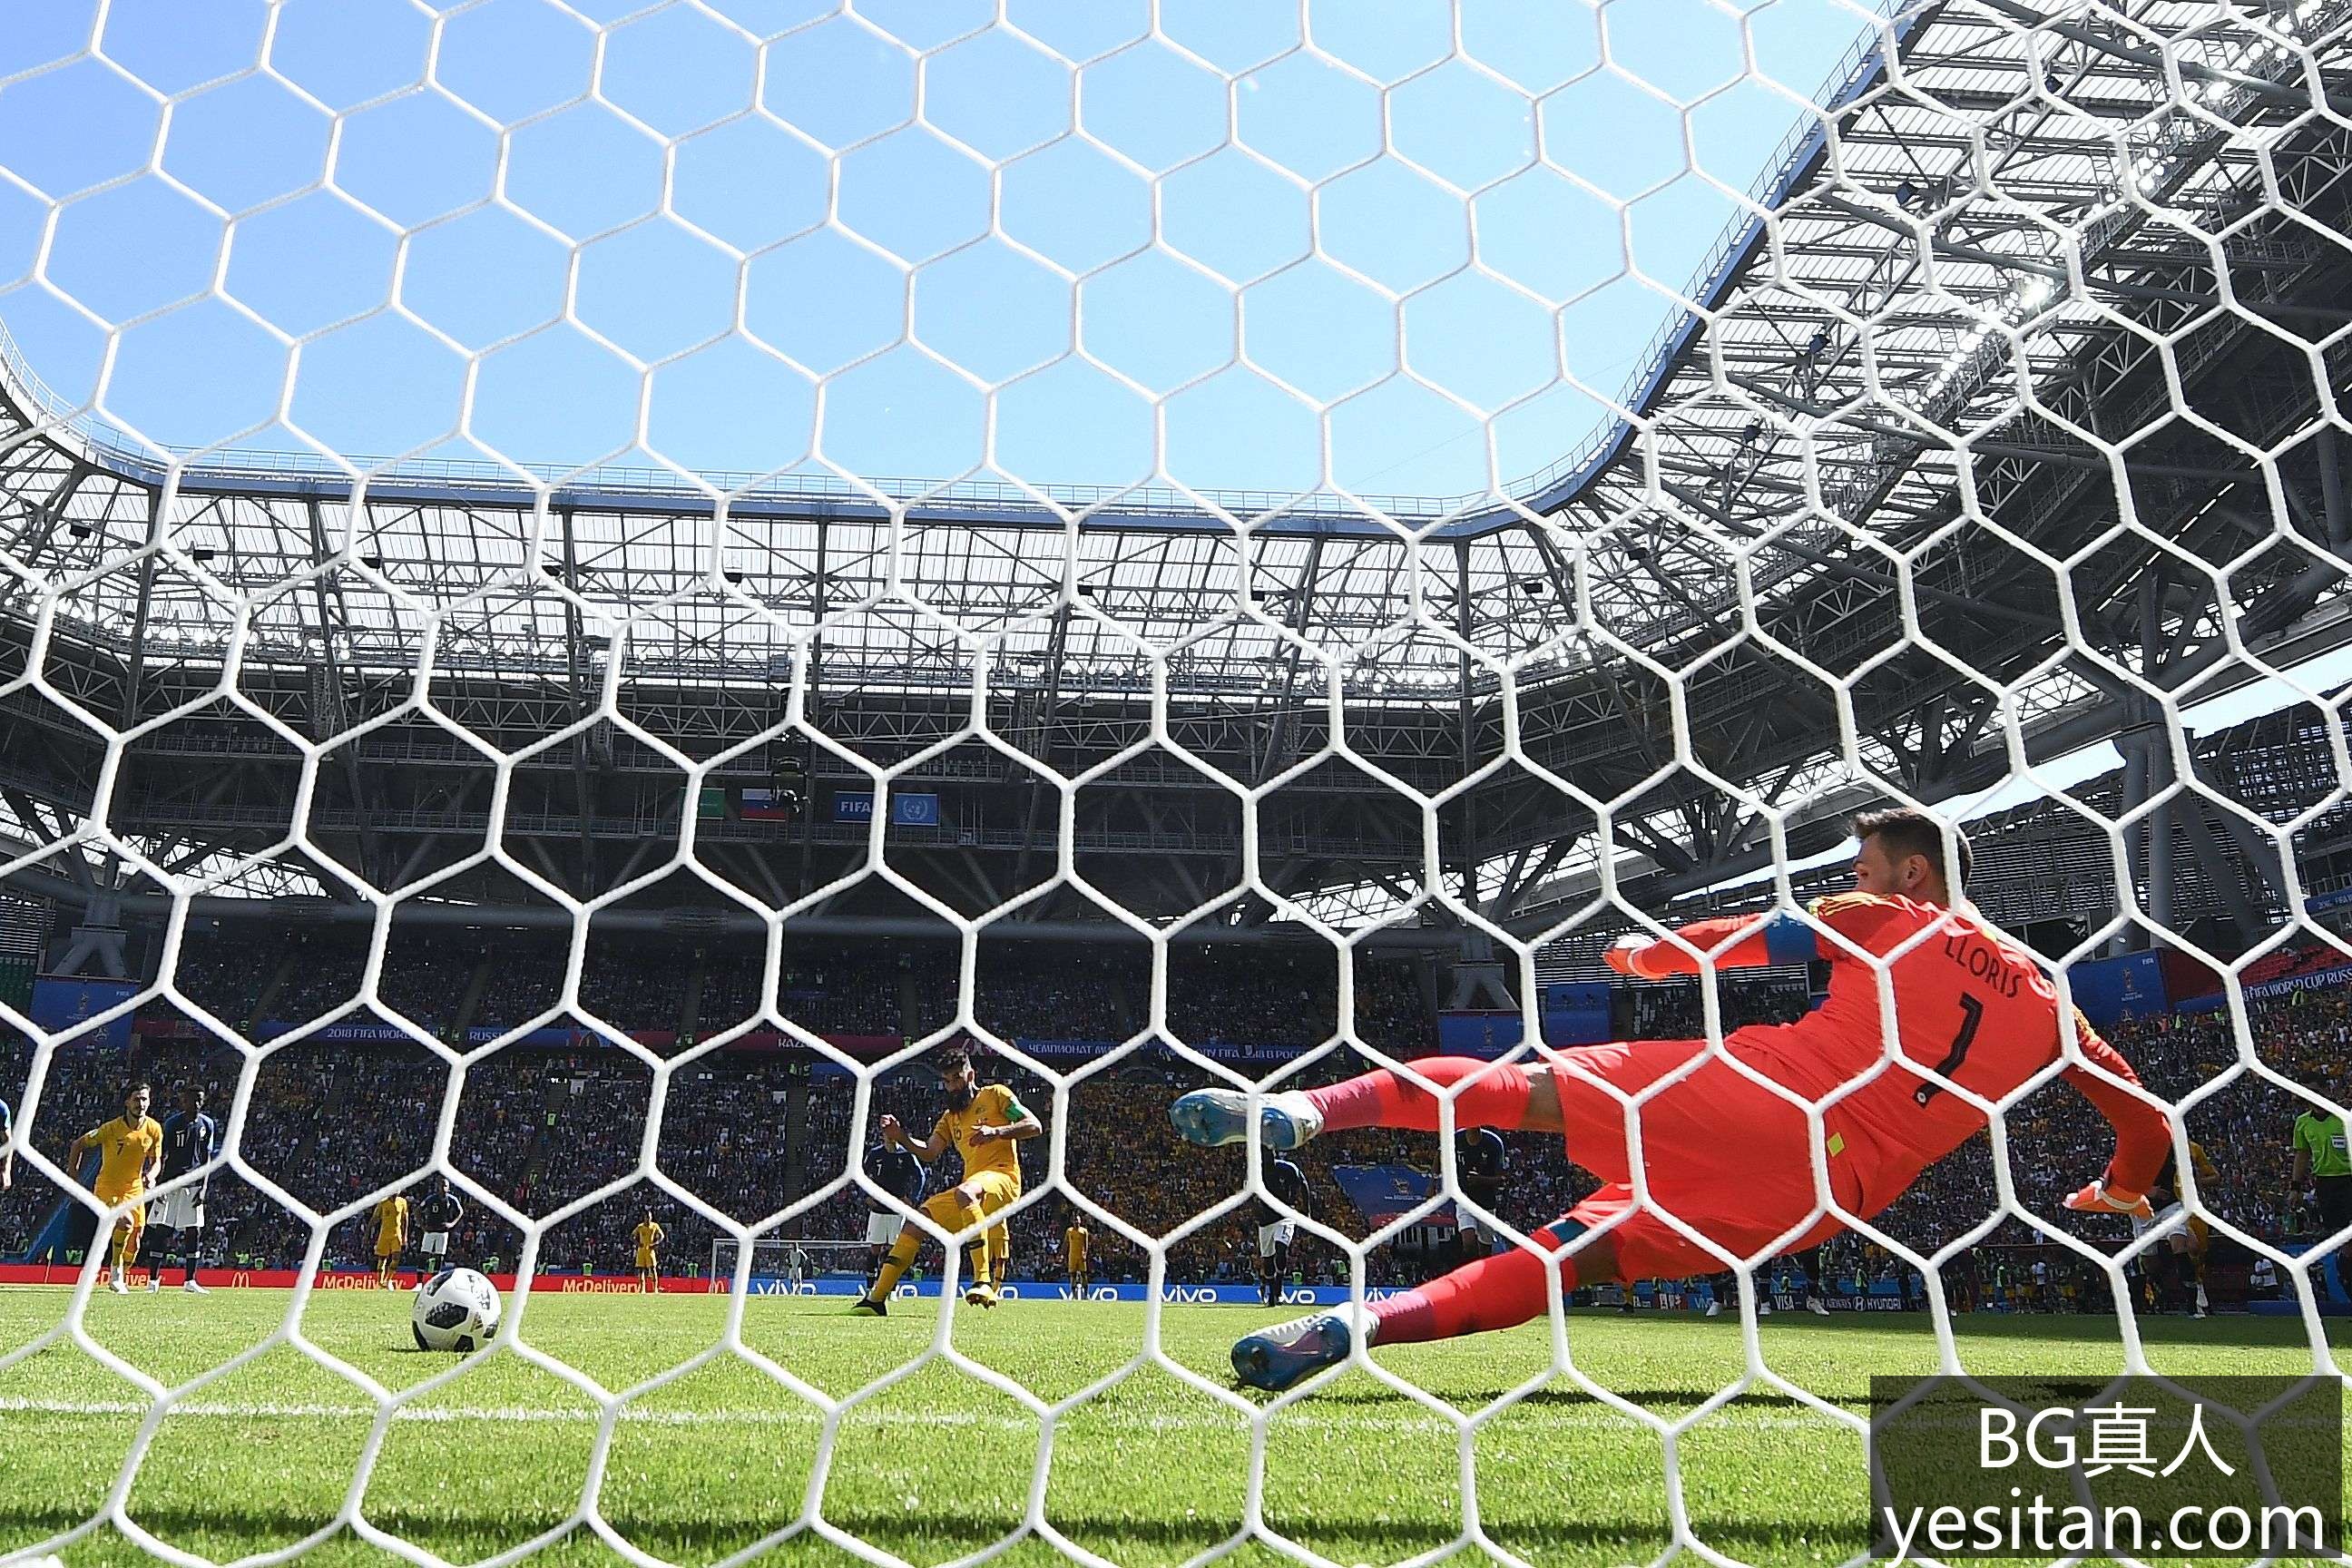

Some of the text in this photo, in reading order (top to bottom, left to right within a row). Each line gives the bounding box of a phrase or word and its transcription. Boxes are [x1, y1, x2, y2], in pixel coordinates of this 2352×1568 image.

[840, 801, 871, 813] FIFA
[1945, 936, 2023, 998] LLORIS
[2250, 985, 2269, 1000] FIFA
[2305, 974, 2325, 989] CUP
[328, 1028, 409, 1040] 2018 FIFA WORL
[1028, 1045, 1092, 1055] ЧЕМПИОНАТ
[1219, 1049, 1239, 1058] FIFA
[1914, 992, 1984, 1109] 7
[176, 1136, 184, 1147] 11
[117, 1141, 124, 1155] 7
[877, 1164, 883, 1176] 7
[1161, 1285, 1218, 1303] vivo
[1773, 1295, 1795, 1310] VISA
[1867, 1298, 1902, 1310] HYUNDAI
